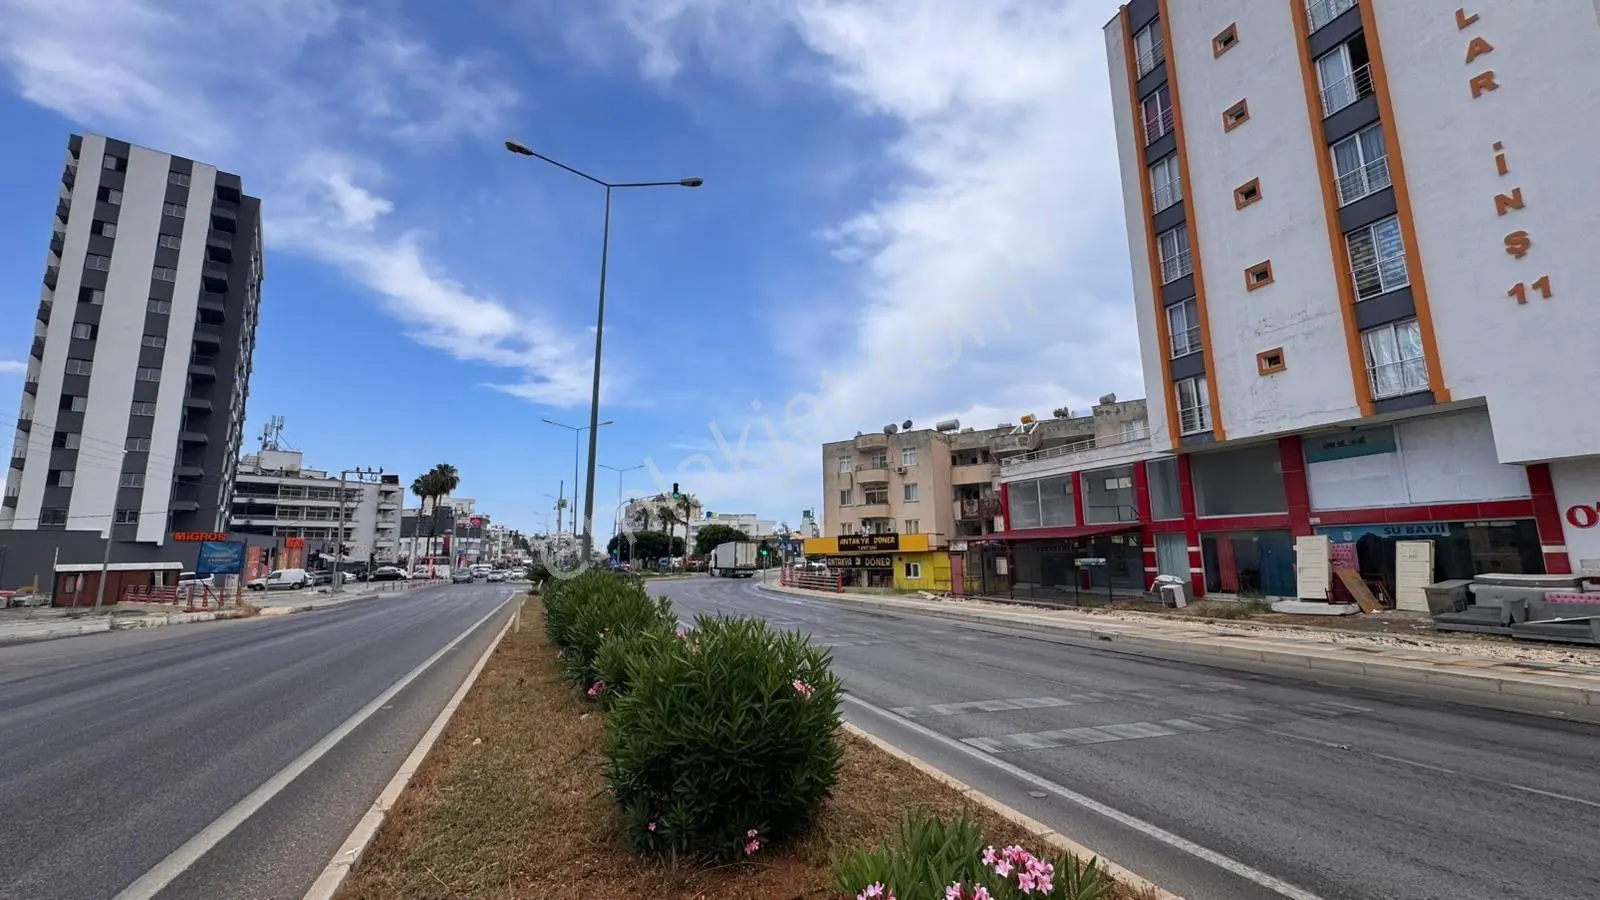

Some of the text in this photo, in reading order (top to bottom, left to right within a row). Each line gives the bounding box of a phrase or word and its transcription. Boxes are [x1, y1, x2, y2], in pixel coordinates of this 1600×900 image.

[1455, 8, 1499, 98] LAR
[1508, 275, 1553, 305] 11
[1384, 527, 1400, 535] SU
[839, 537, 869, 545] ANTAKYA
[827, 557, 852, 566] ANTAKYA
